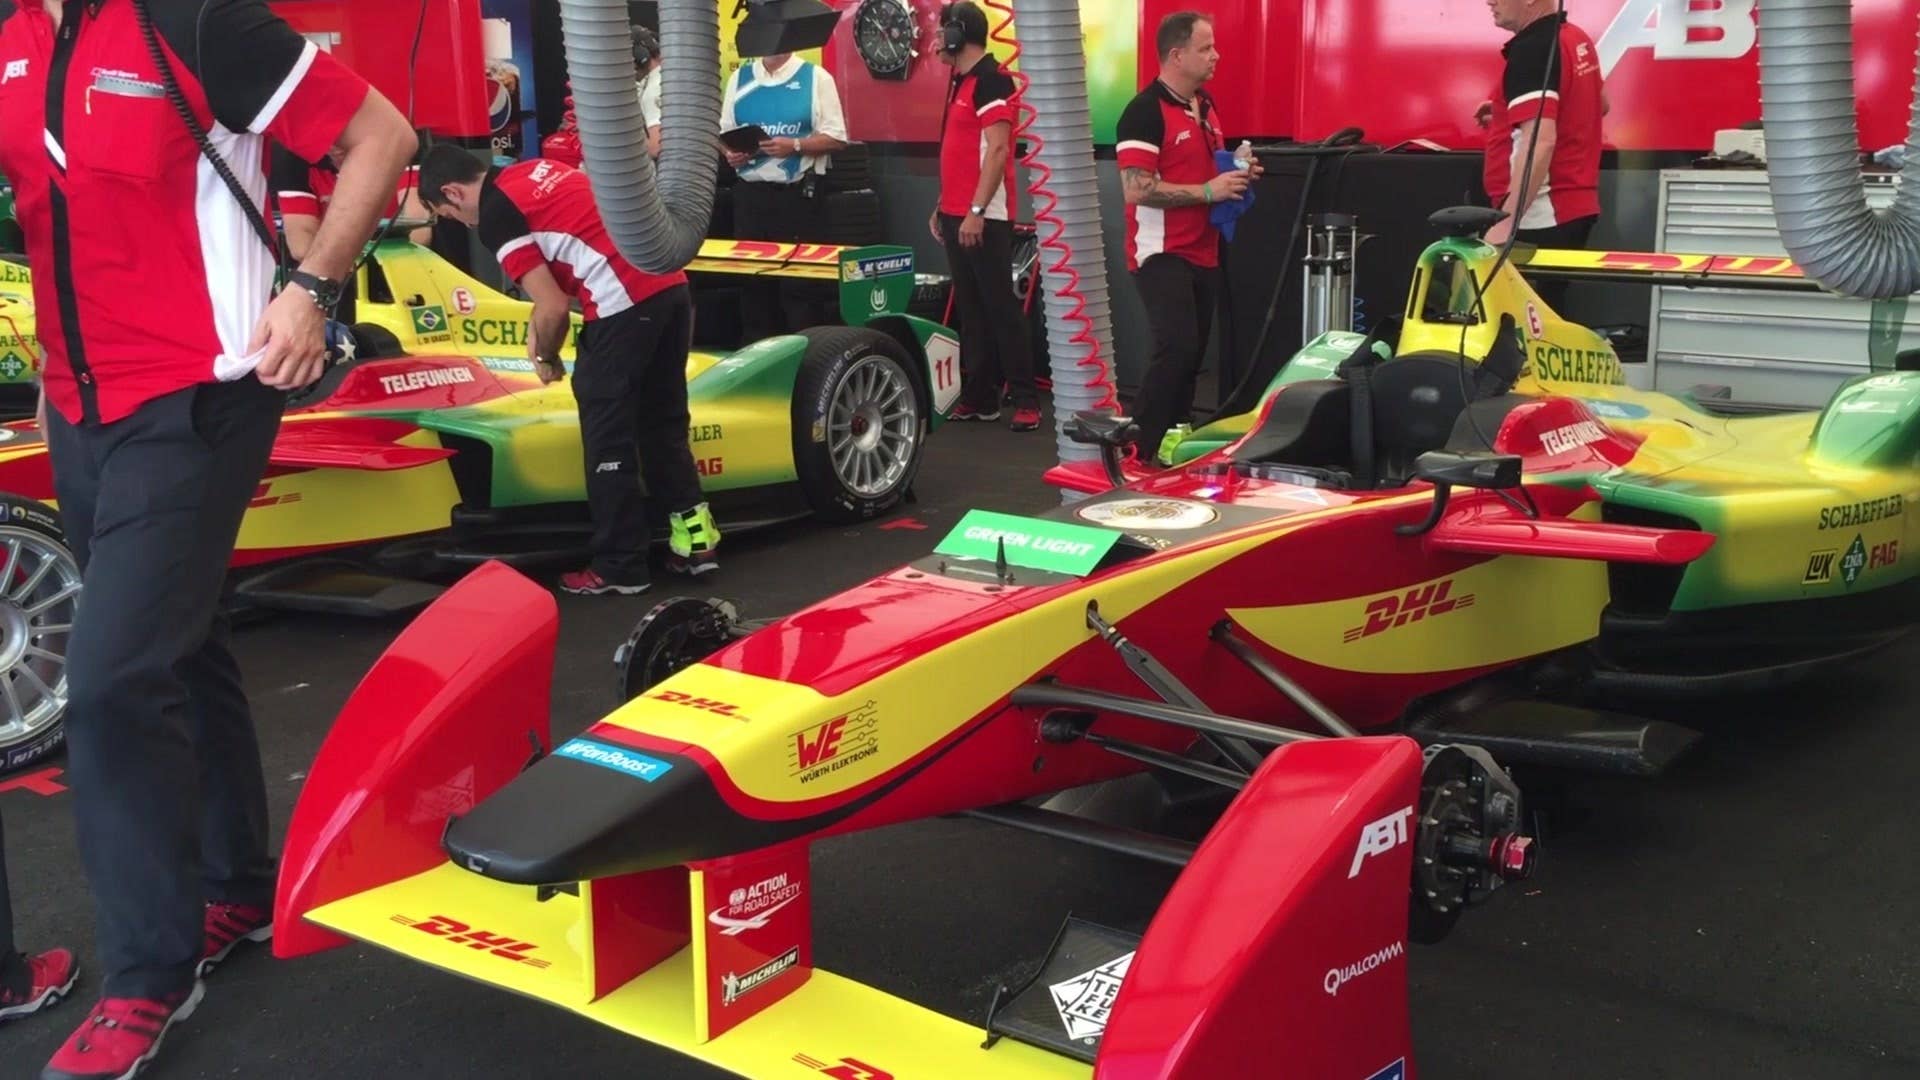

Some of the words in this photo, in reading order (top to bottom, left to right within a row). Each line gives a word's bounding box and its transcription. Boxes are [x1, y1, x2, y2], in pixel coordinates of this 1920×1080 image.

[864, 257, 912, 273] MCHELIN
[455, 290, 472, 313] E
[1528, 305, 1540, 334] E
[380, 366, 475, 395] TELEFUNKEN
[935, 356, 953, 391] 11
[1817, 493, 1903, 530] SCHAEFFLER
[964, 526, 1031, 548] GREEN
[1031, 534, 1096, 557] LIGHT
[1868, 540, 1899, 570] FAG
[1360, 579, 1457, 638] DHL
[652, 690, 740, 717] DHL
[562, 743, 657, 775] #FanBoost
[797, 716, 849, 770] WE
[800, 765, 830, 785] WÜRTH
[831, 745, 879, 772] ELEKTRONIK
[1347, 804, 1414, 880] ABT
[728, 902, 743, 916] FOR
[744, 894, 770, 914] ROAD
[770, 881, 801, 905] SAFETY
[747, 872, 788, 901] ACTION
[408, 914, 540, 962] DHL
[740, 950, 797, 990] MICHELIN
[1323, 941, 1404, 996] QUALCOMM
